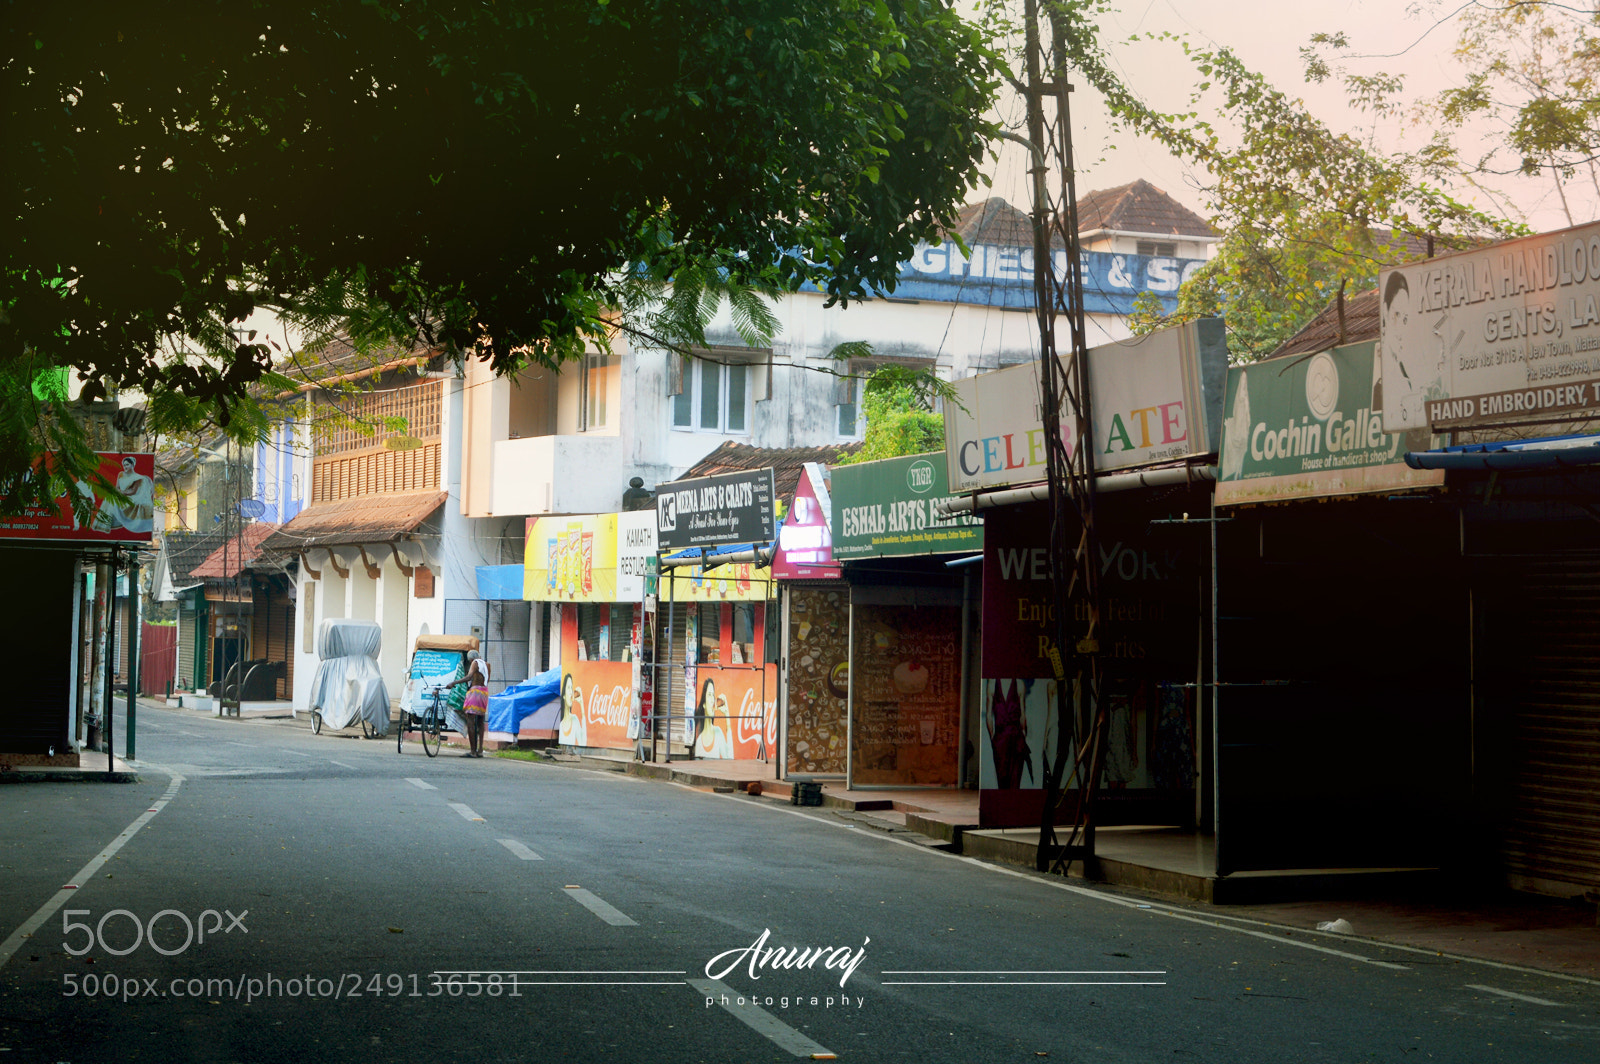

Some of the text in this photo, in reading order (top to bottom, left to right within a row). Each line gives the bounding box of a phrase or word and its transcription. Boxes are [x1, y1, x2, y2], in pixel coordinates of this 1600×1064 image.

[1108, 255, 1134, 288] &
[1416, 257, 1495, 314] KERALA
[1484, 302, 1563, 343] GENTS,
[1459, 353, 1478, 371] Door
[1528, 343, 1545, 360] Jew
[1547, 340, 1573, 357] Town,
[1430, 399, 1475, 421] HAND
[1480, 384, 1588, 416] EMBROIDERY,
[959, 400, 1188, 477] CELEBATE
[1251, 415, 1321, 461] Cochin
[1301, 456, 1324, 470] House
[1324, 454, 1332, 468] of
[1369, 449, 1388, 466] shop
[675, 481, 753, 514] MEENA ARTS & CRAFTS
[707, 511, 716, 527] For
[716, 510, 728, 527] Your
[728, 509, 739, 532] Eyes
[842, 503, 887, 537] ESHAL
[888, 499, 927, 533] ARTS
[626, 528, 652, 548] KAMATH
[1107, 598, 1144, 622] Feel
[587, 683, 630, 727] Coca-Cola
